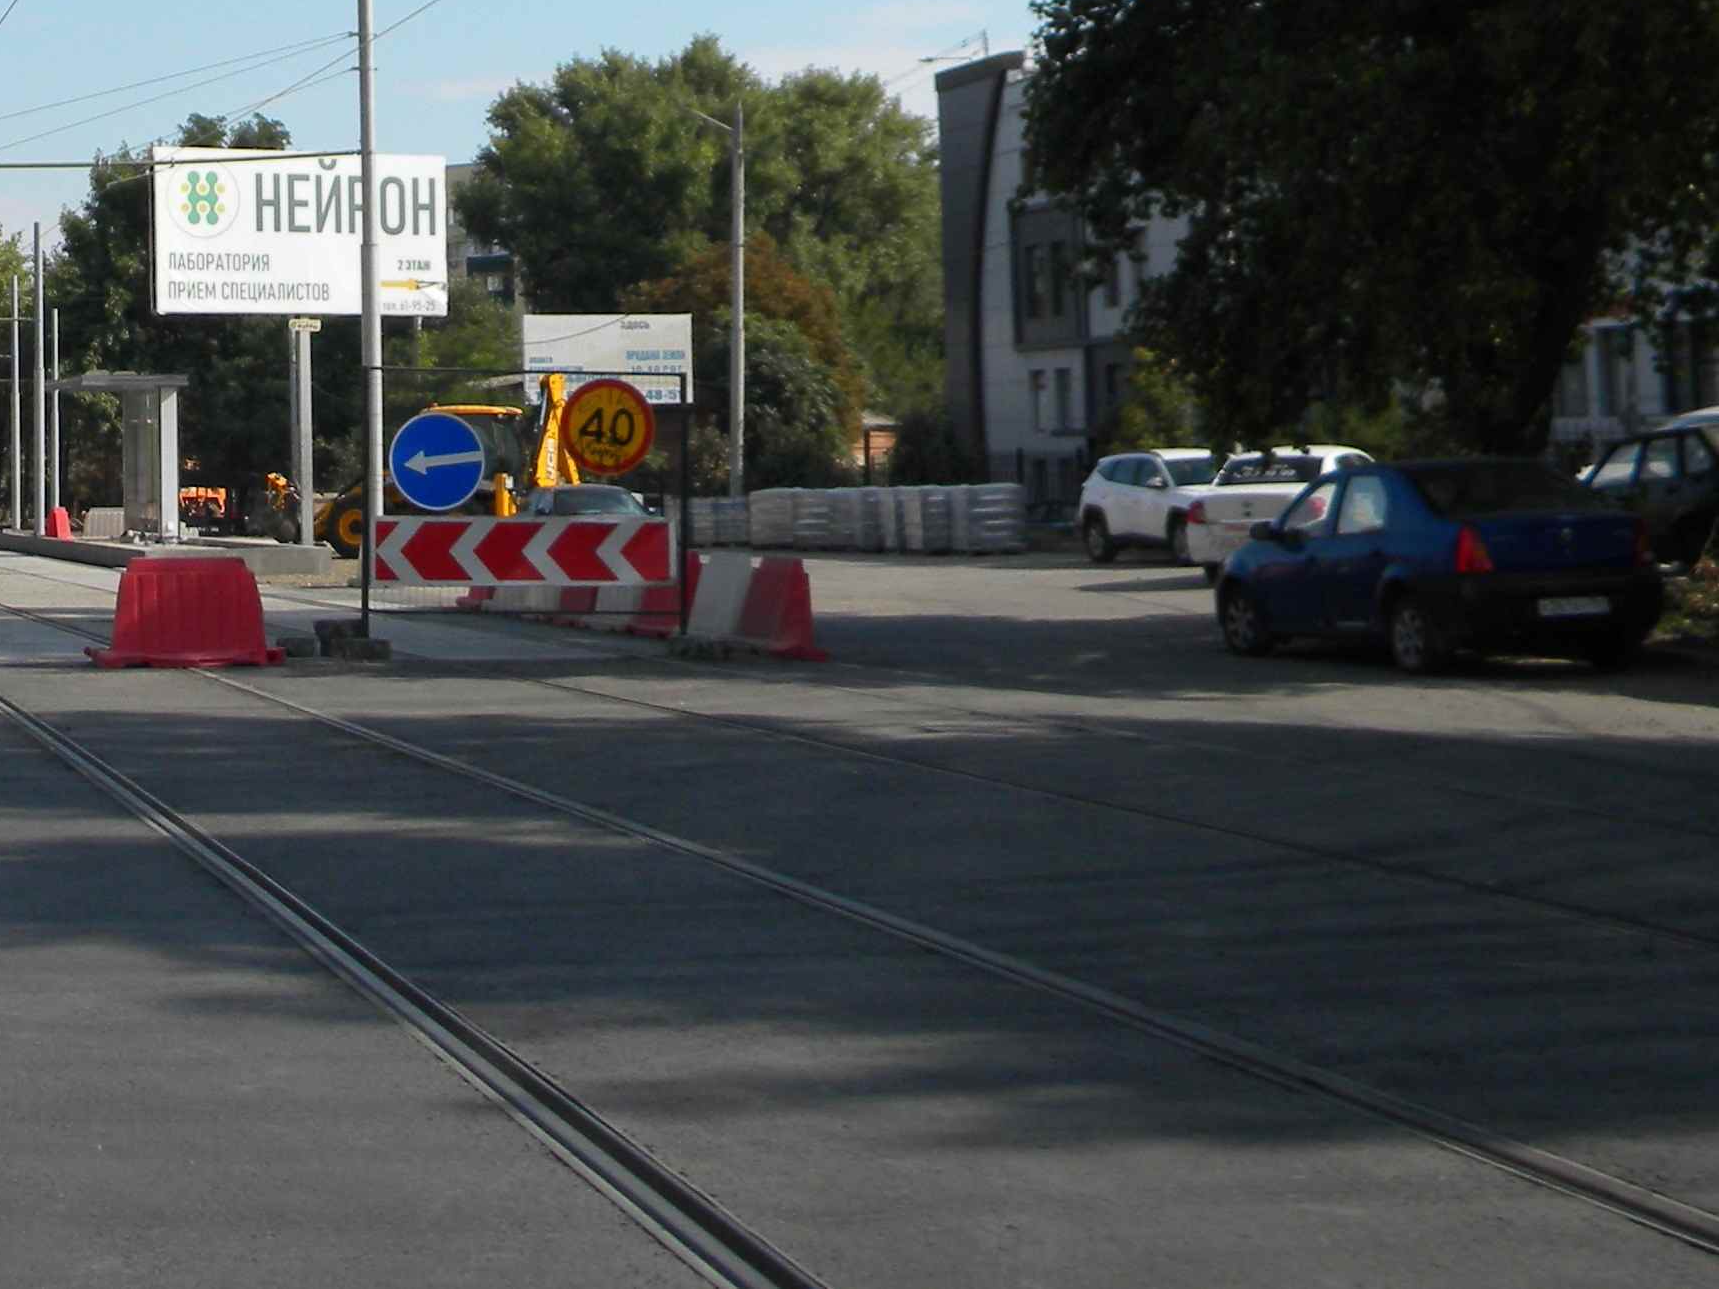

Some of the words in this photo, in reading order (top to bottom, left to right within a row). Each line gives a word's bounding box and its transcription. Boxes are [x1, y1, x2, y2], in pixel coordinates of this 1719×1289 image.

[255, 158, 436, 236] НЕЙРОН
[168, 252, 270, 271] ЛАБОРАТОРИЯ
[397, 259, 404, 271] 2
[168, 281, 216, 300] ПРИЕМ
[221, 282, 330, 302] СПЕЦИАЛИСТОВ
[579, 407, 635, 446] 40
